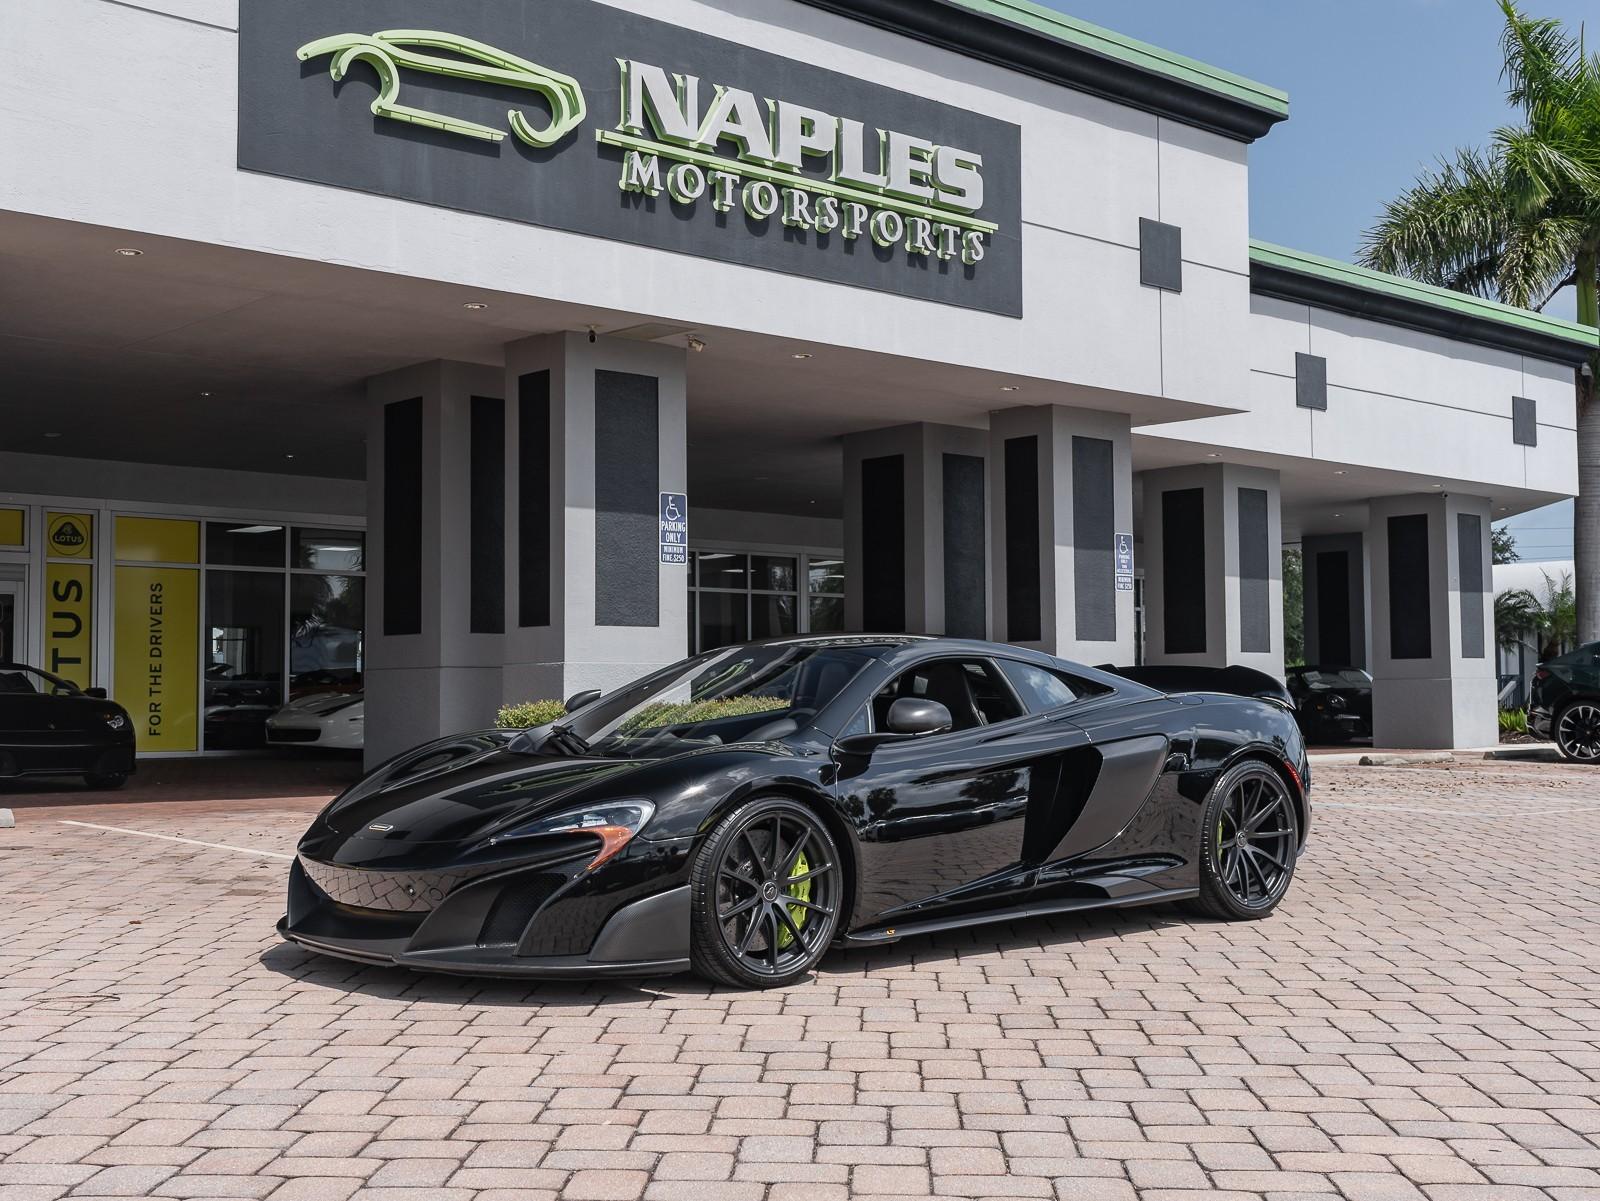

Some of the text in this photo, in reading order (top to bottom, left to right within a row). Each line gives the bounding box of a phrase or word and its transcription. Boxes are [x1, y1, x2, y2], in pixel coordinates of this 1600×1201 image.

[616, 57, 984, 213] NAPLES
[619, 150, 984, 264] MOTORSPORTS
[54, 535, 82, 543] LOTUS
[661, 521, 686, 532] PARKING
[665, 532, 681, 543] ONLY
[149, 582, 163, 736] FOR THE DRIVERS
